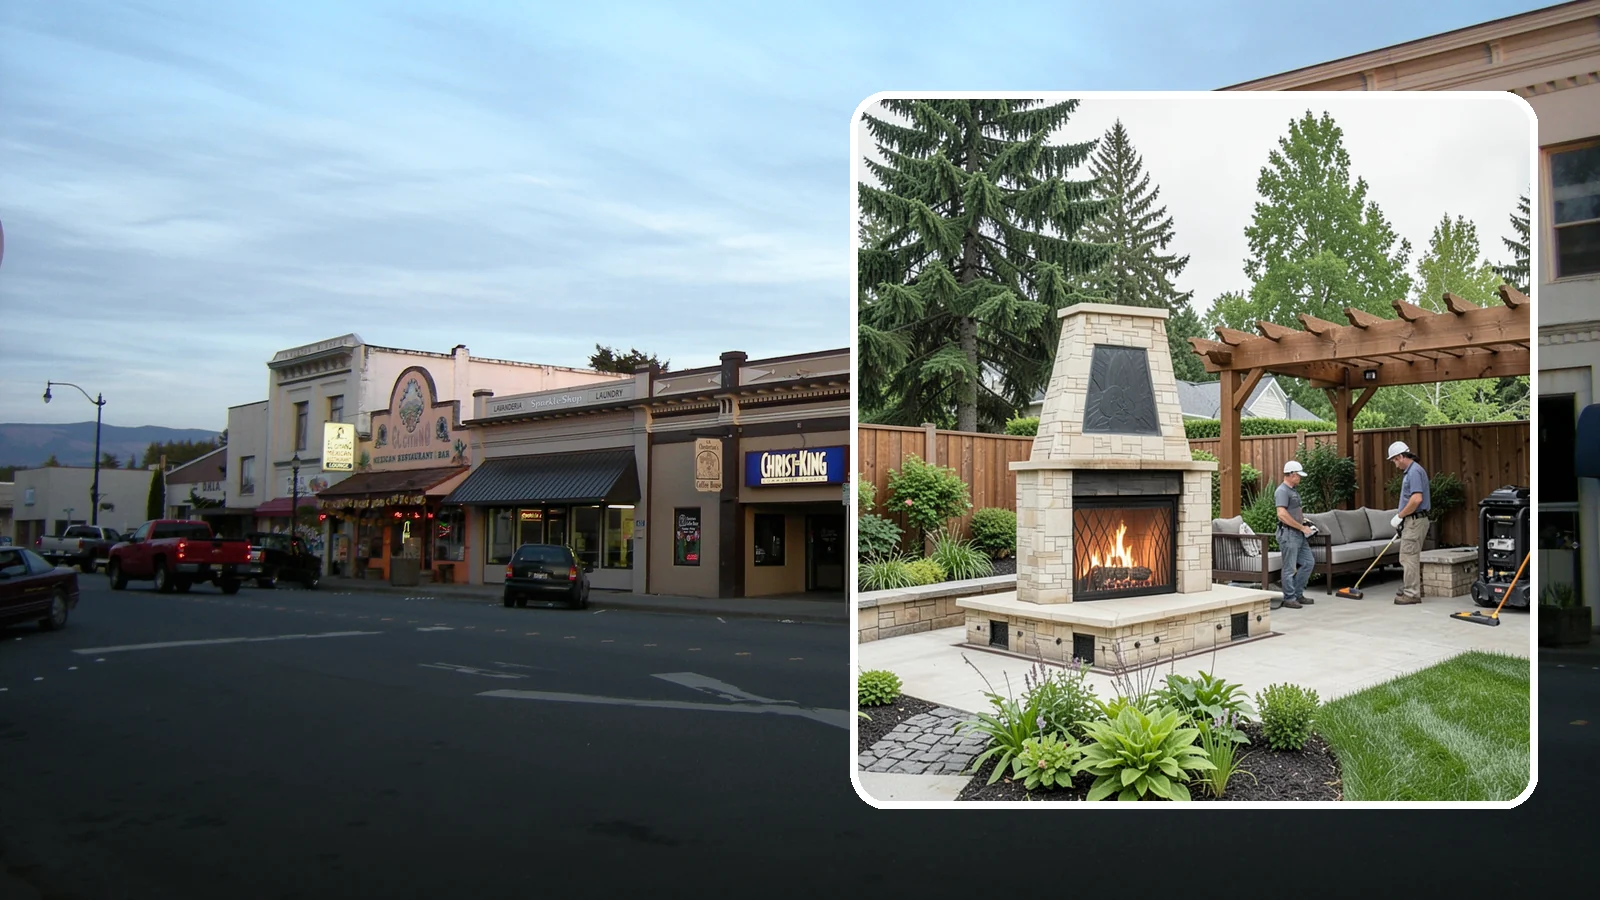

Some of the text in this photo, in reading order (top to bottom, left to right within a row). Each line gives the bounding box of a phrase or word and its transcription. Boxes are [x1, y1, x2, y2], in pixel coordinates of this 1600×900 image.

[595, 389, 624, 400] LAUNDRY
[493, 402, 523, 413] LAVANDERIA
[531, 394, 582, 409] Sparkle Shop
[373, 455, 396, 464] MEXICAN
[397, 451, 434, 462] RESTAURANT
[437, 450, 450, 460] BAR
[799, 450, 827, 476] KING
[696, 481, 709, 489] Coffee
